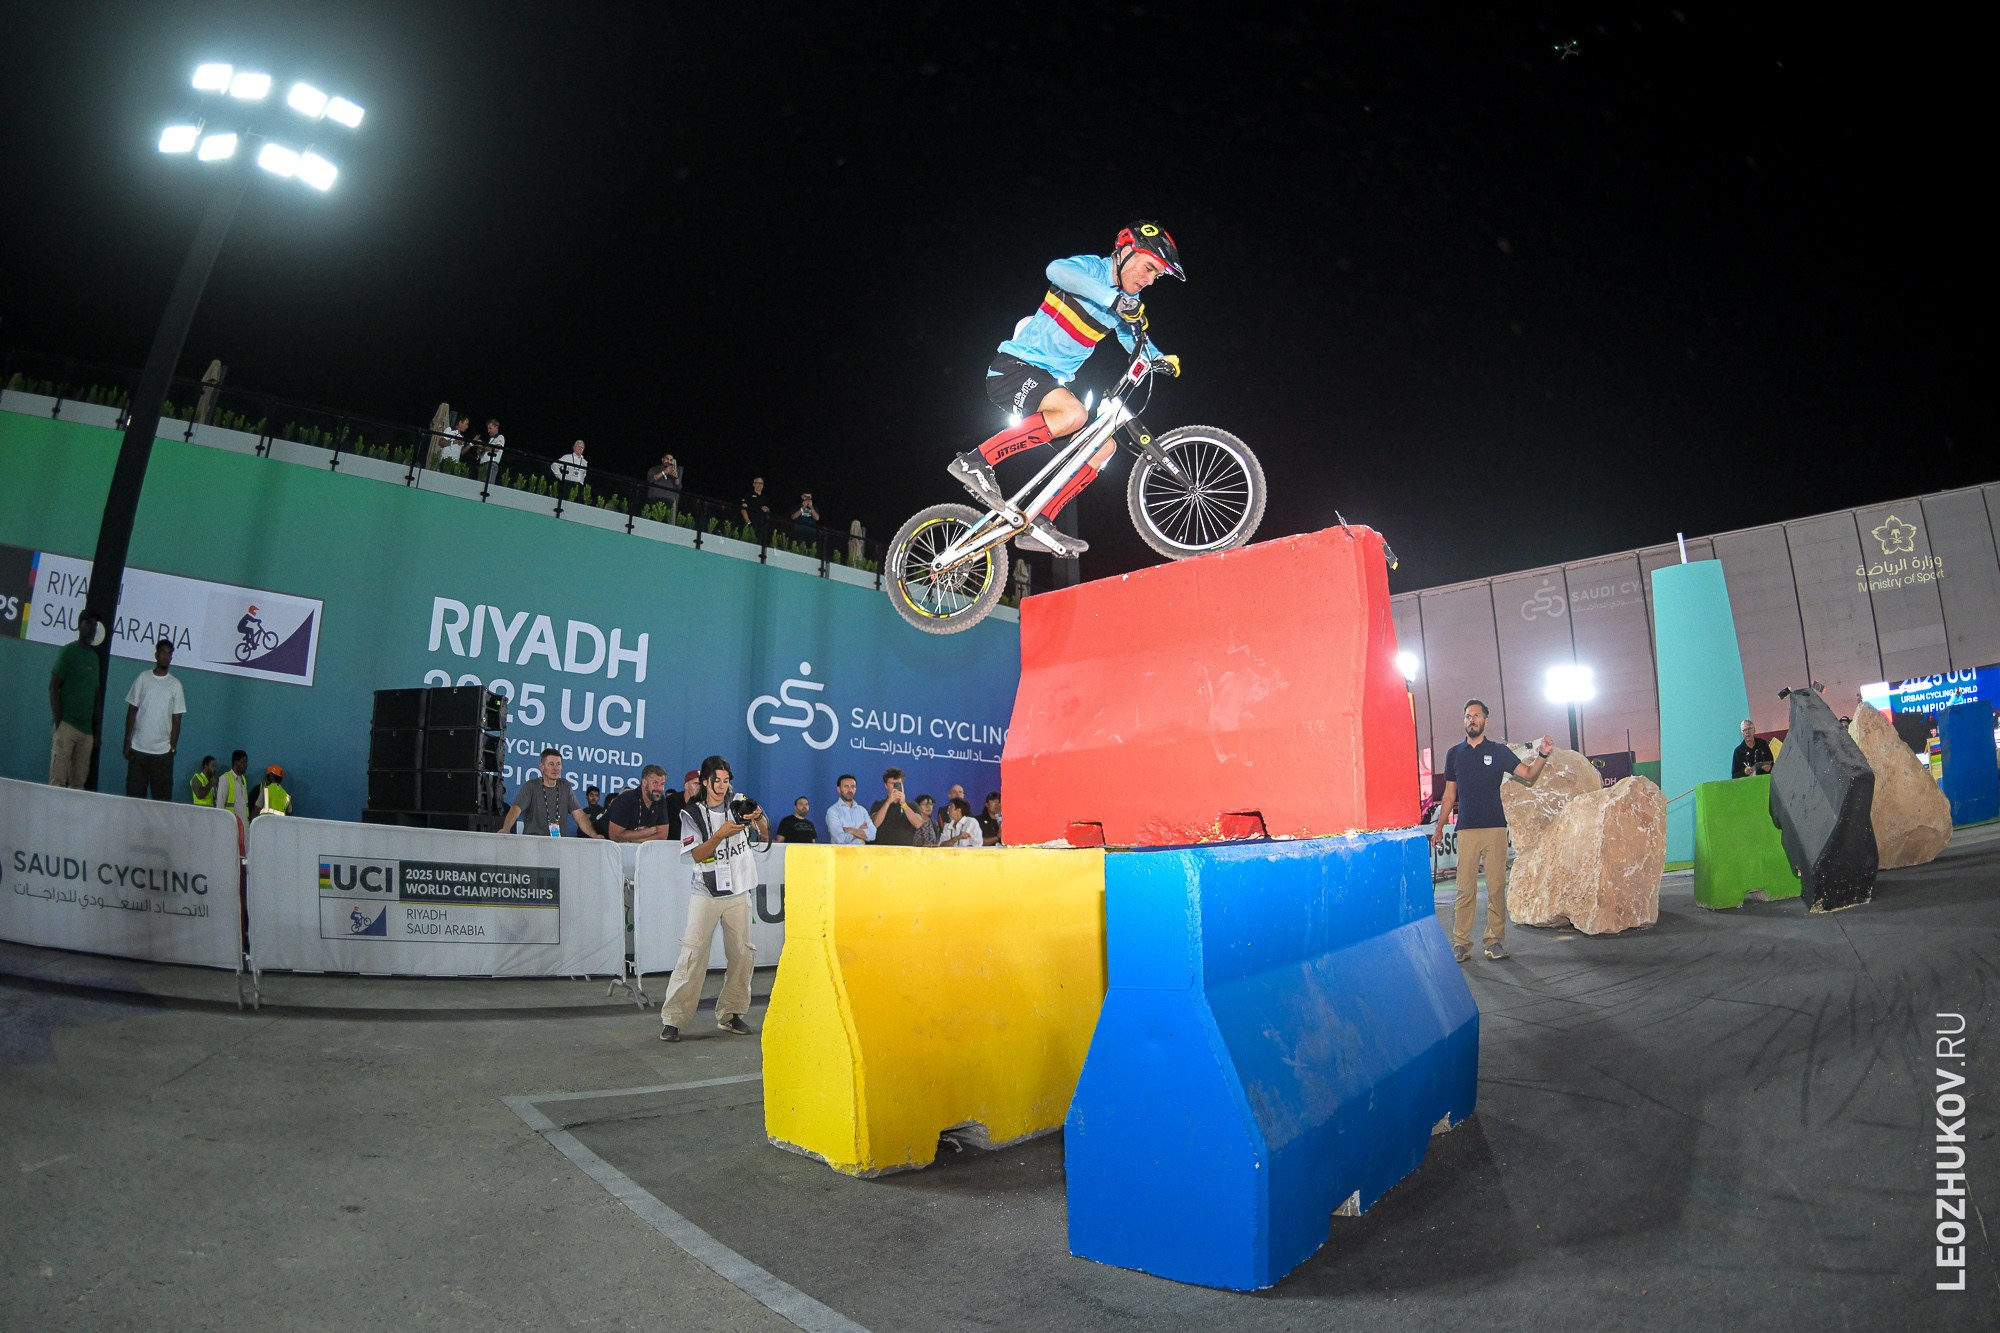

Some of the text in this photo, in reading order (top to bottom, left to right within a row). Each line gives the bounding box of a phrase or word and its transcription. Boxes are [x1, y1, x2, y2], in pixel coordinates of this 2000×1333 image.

[1856, 555, 1942, 576] وزارة الرياضة
[1571, 585, 1615, 601] SAUDI
[1858, 577, 1902, 593] Ministry
[1904, 573, 1915, 585] of
[113, 616, 191, 651] ARABIA
[428, 596, 649, 683] RIYADH
[1946, 667, 1977, 684] UCI
[1900, 693, 1925, 704] URBAN
[1926, 688, 1954, 700] CYCLING
[560, 688, 646, 739] UCI
[851, 707, 922, 736] SAUDI
[577, 745, 643, 767] WORLD
[850, 736, 912, 756] للدراجات
[912, 745, 972, 761] السعودي
[717, 841, 746, 861] STAFF
[14, 850, 209, 895] SAUDI CYCLING
[333, 863, 393, 893] UCI
[405, 868, 531, 885] 2025 URBAN CYCLING
[14, 882, 209, 918] الاتحاد السعودي للدراجات
[406, 883, 554, 900] WORLD CHAMPIONSHIPS
[406, 908, 447, 921] RIYADH
[406, 923, 485, 937] SAUDI ARABIA
